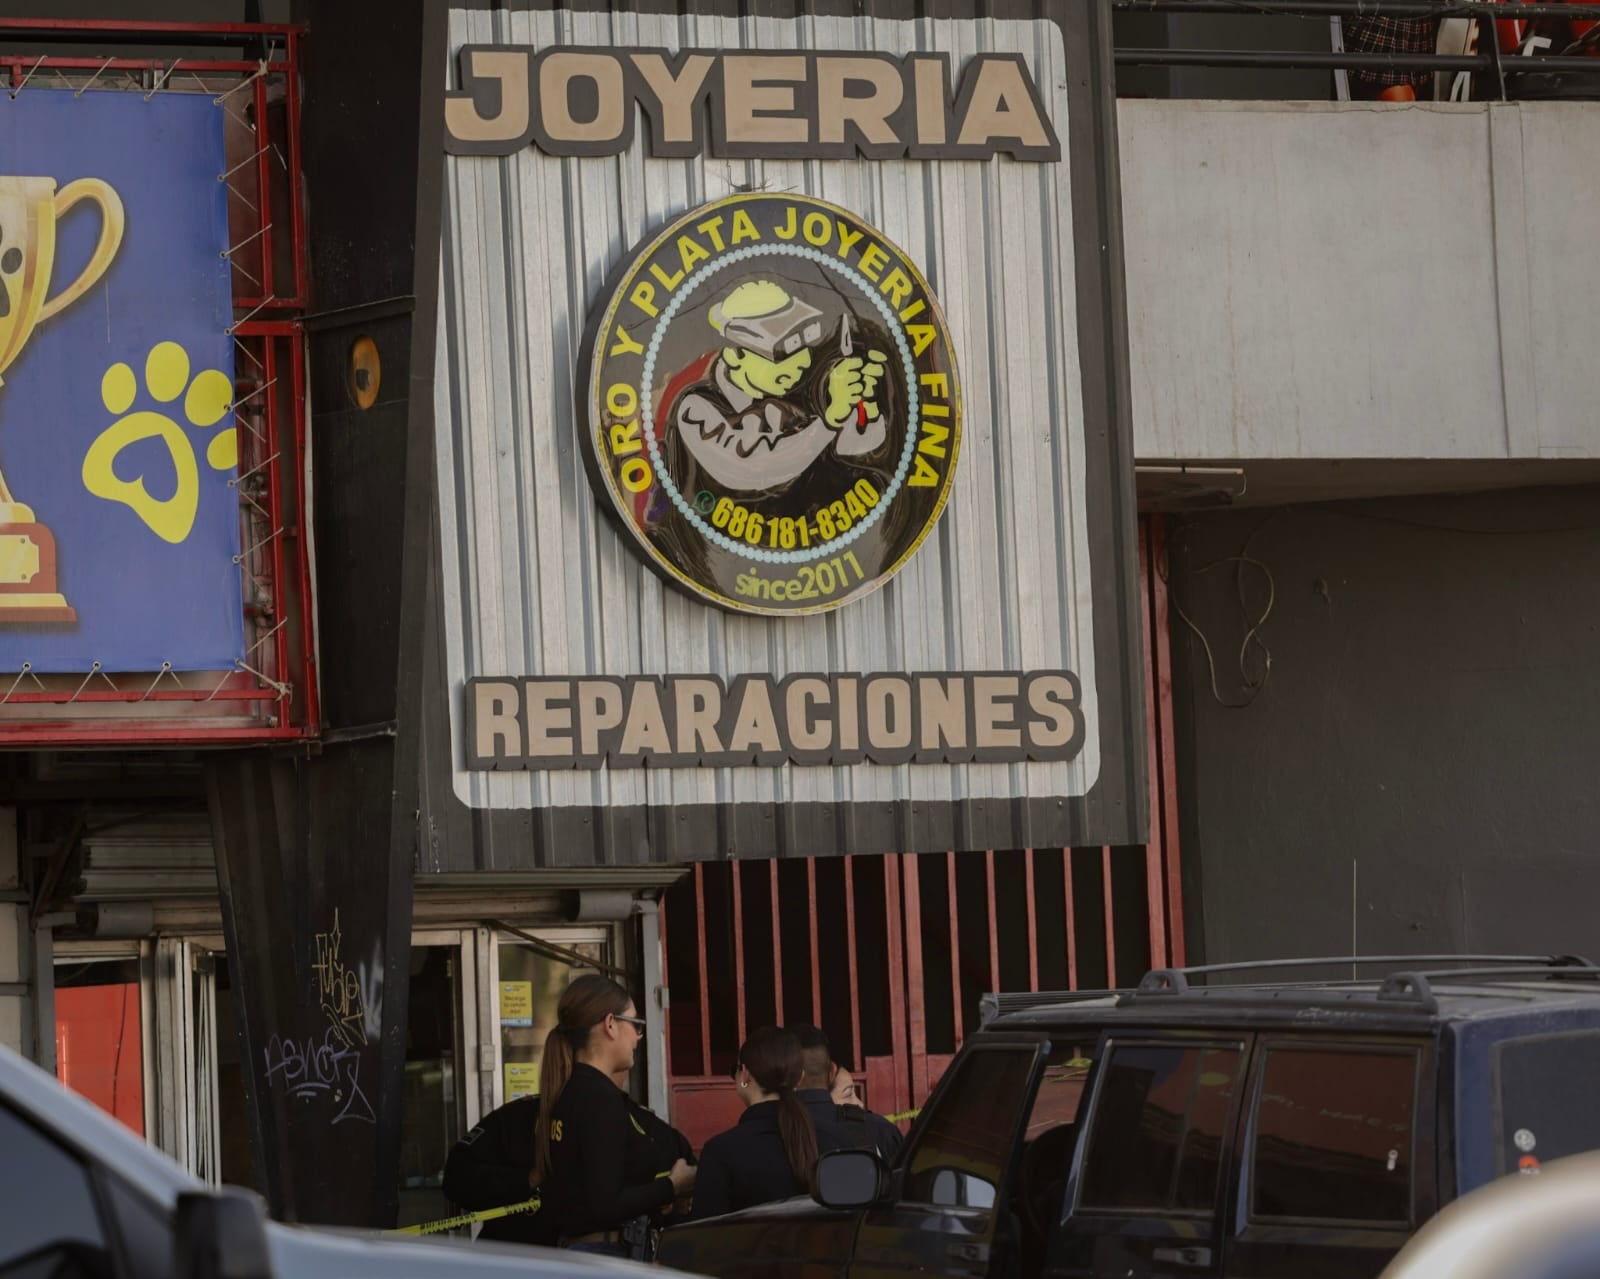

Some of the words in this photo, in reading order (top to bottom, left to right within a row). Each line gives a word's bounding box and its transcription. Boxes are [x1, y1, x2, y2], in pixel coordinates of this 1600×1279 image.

[444, 51, 1052, 148] JOYERIA
[629, 209, 761, 319] PLATA
[774, 207, 936, 358] JOYERIA
[610, 324, 645, 358] Y
[606, 383, 652, 493] ORO
[907, 372, 950, 489] FINA
[473, 675, 1077, 758] REPARACIONES
